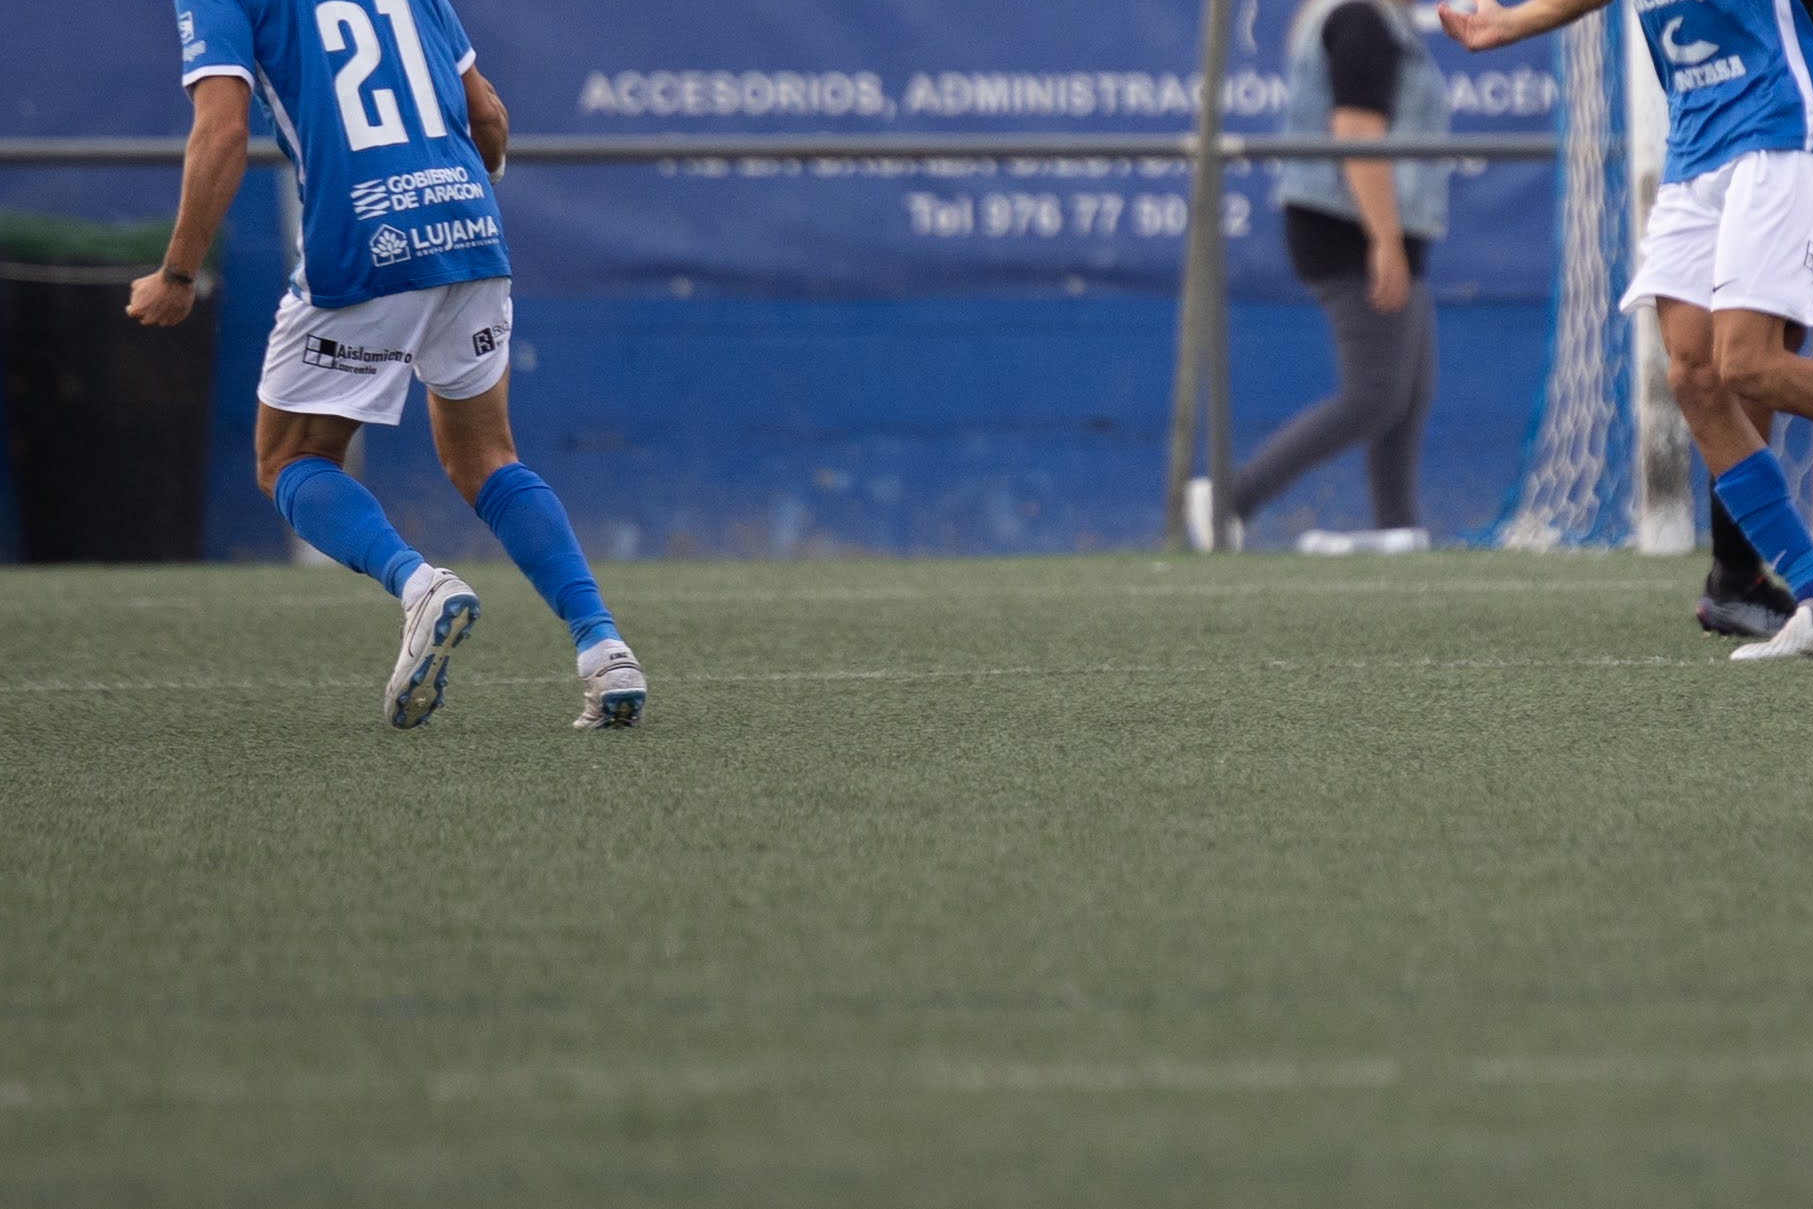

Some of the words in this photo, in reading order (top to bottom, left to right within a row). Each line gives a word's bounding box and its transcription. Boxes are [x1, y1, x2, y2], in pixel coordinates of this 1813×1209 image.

[387, 166, 469, 193] GOBIERNO
[391, 191, 420, 211] DE
[1070, 194, 1125, 235] 77
[410, 216, 499, 250] LUJAMA
